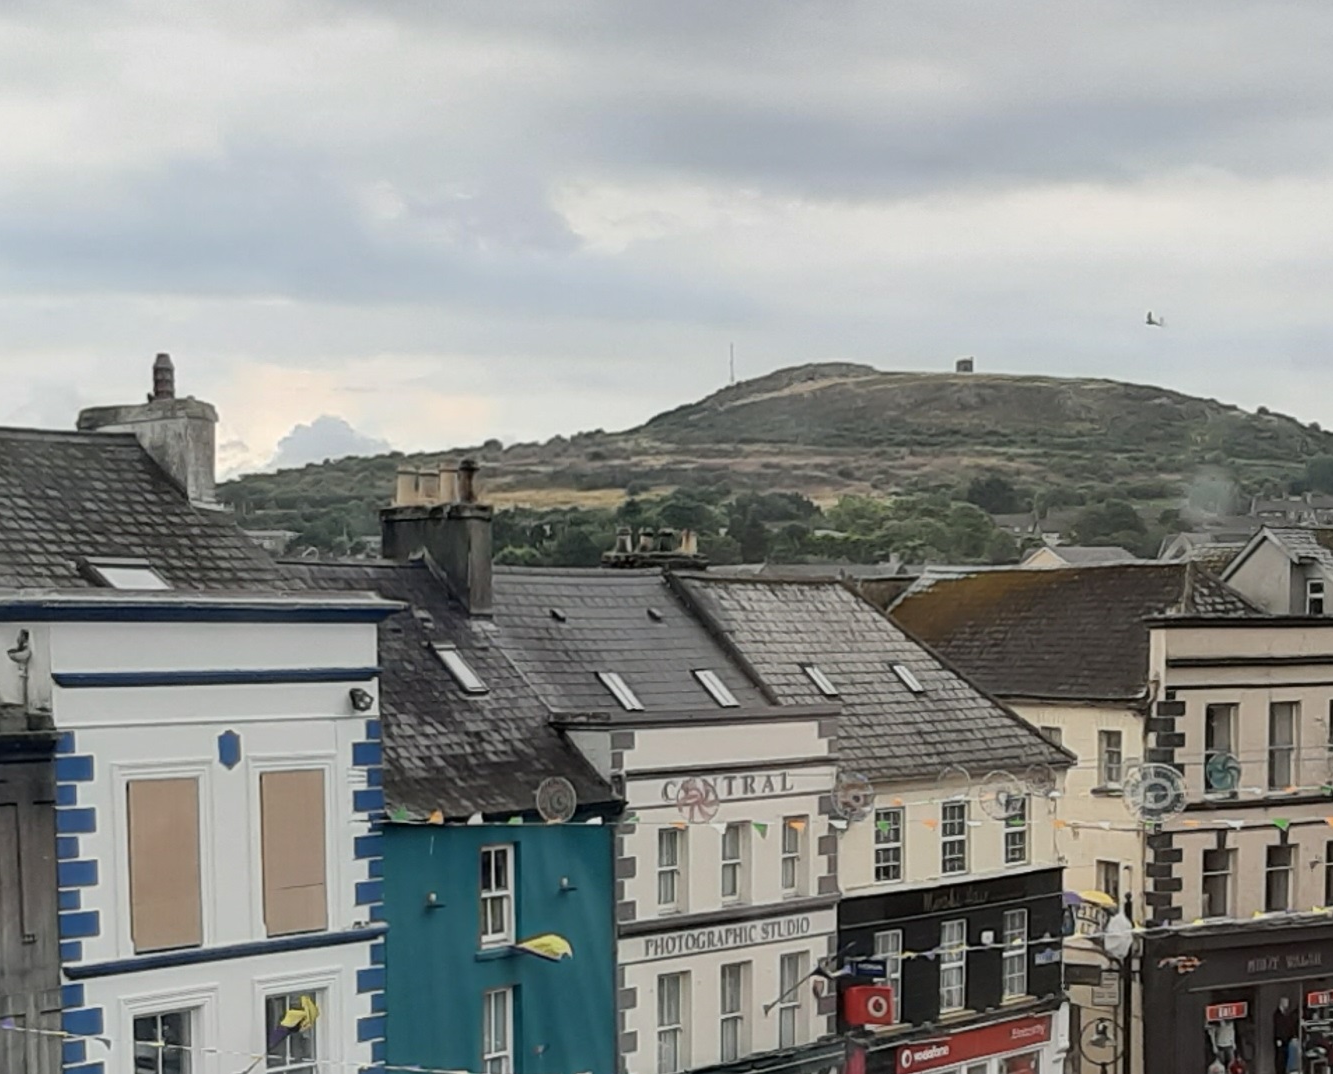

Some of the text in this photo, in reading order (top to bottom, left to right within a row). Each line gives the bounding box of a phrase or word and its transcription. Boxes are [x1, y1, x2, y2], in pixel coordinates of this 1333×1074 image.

[661, 771, 794, 803] CNTRAL
[644, 916, 810, 957] PHOTOGRAPHIC STUDIO
